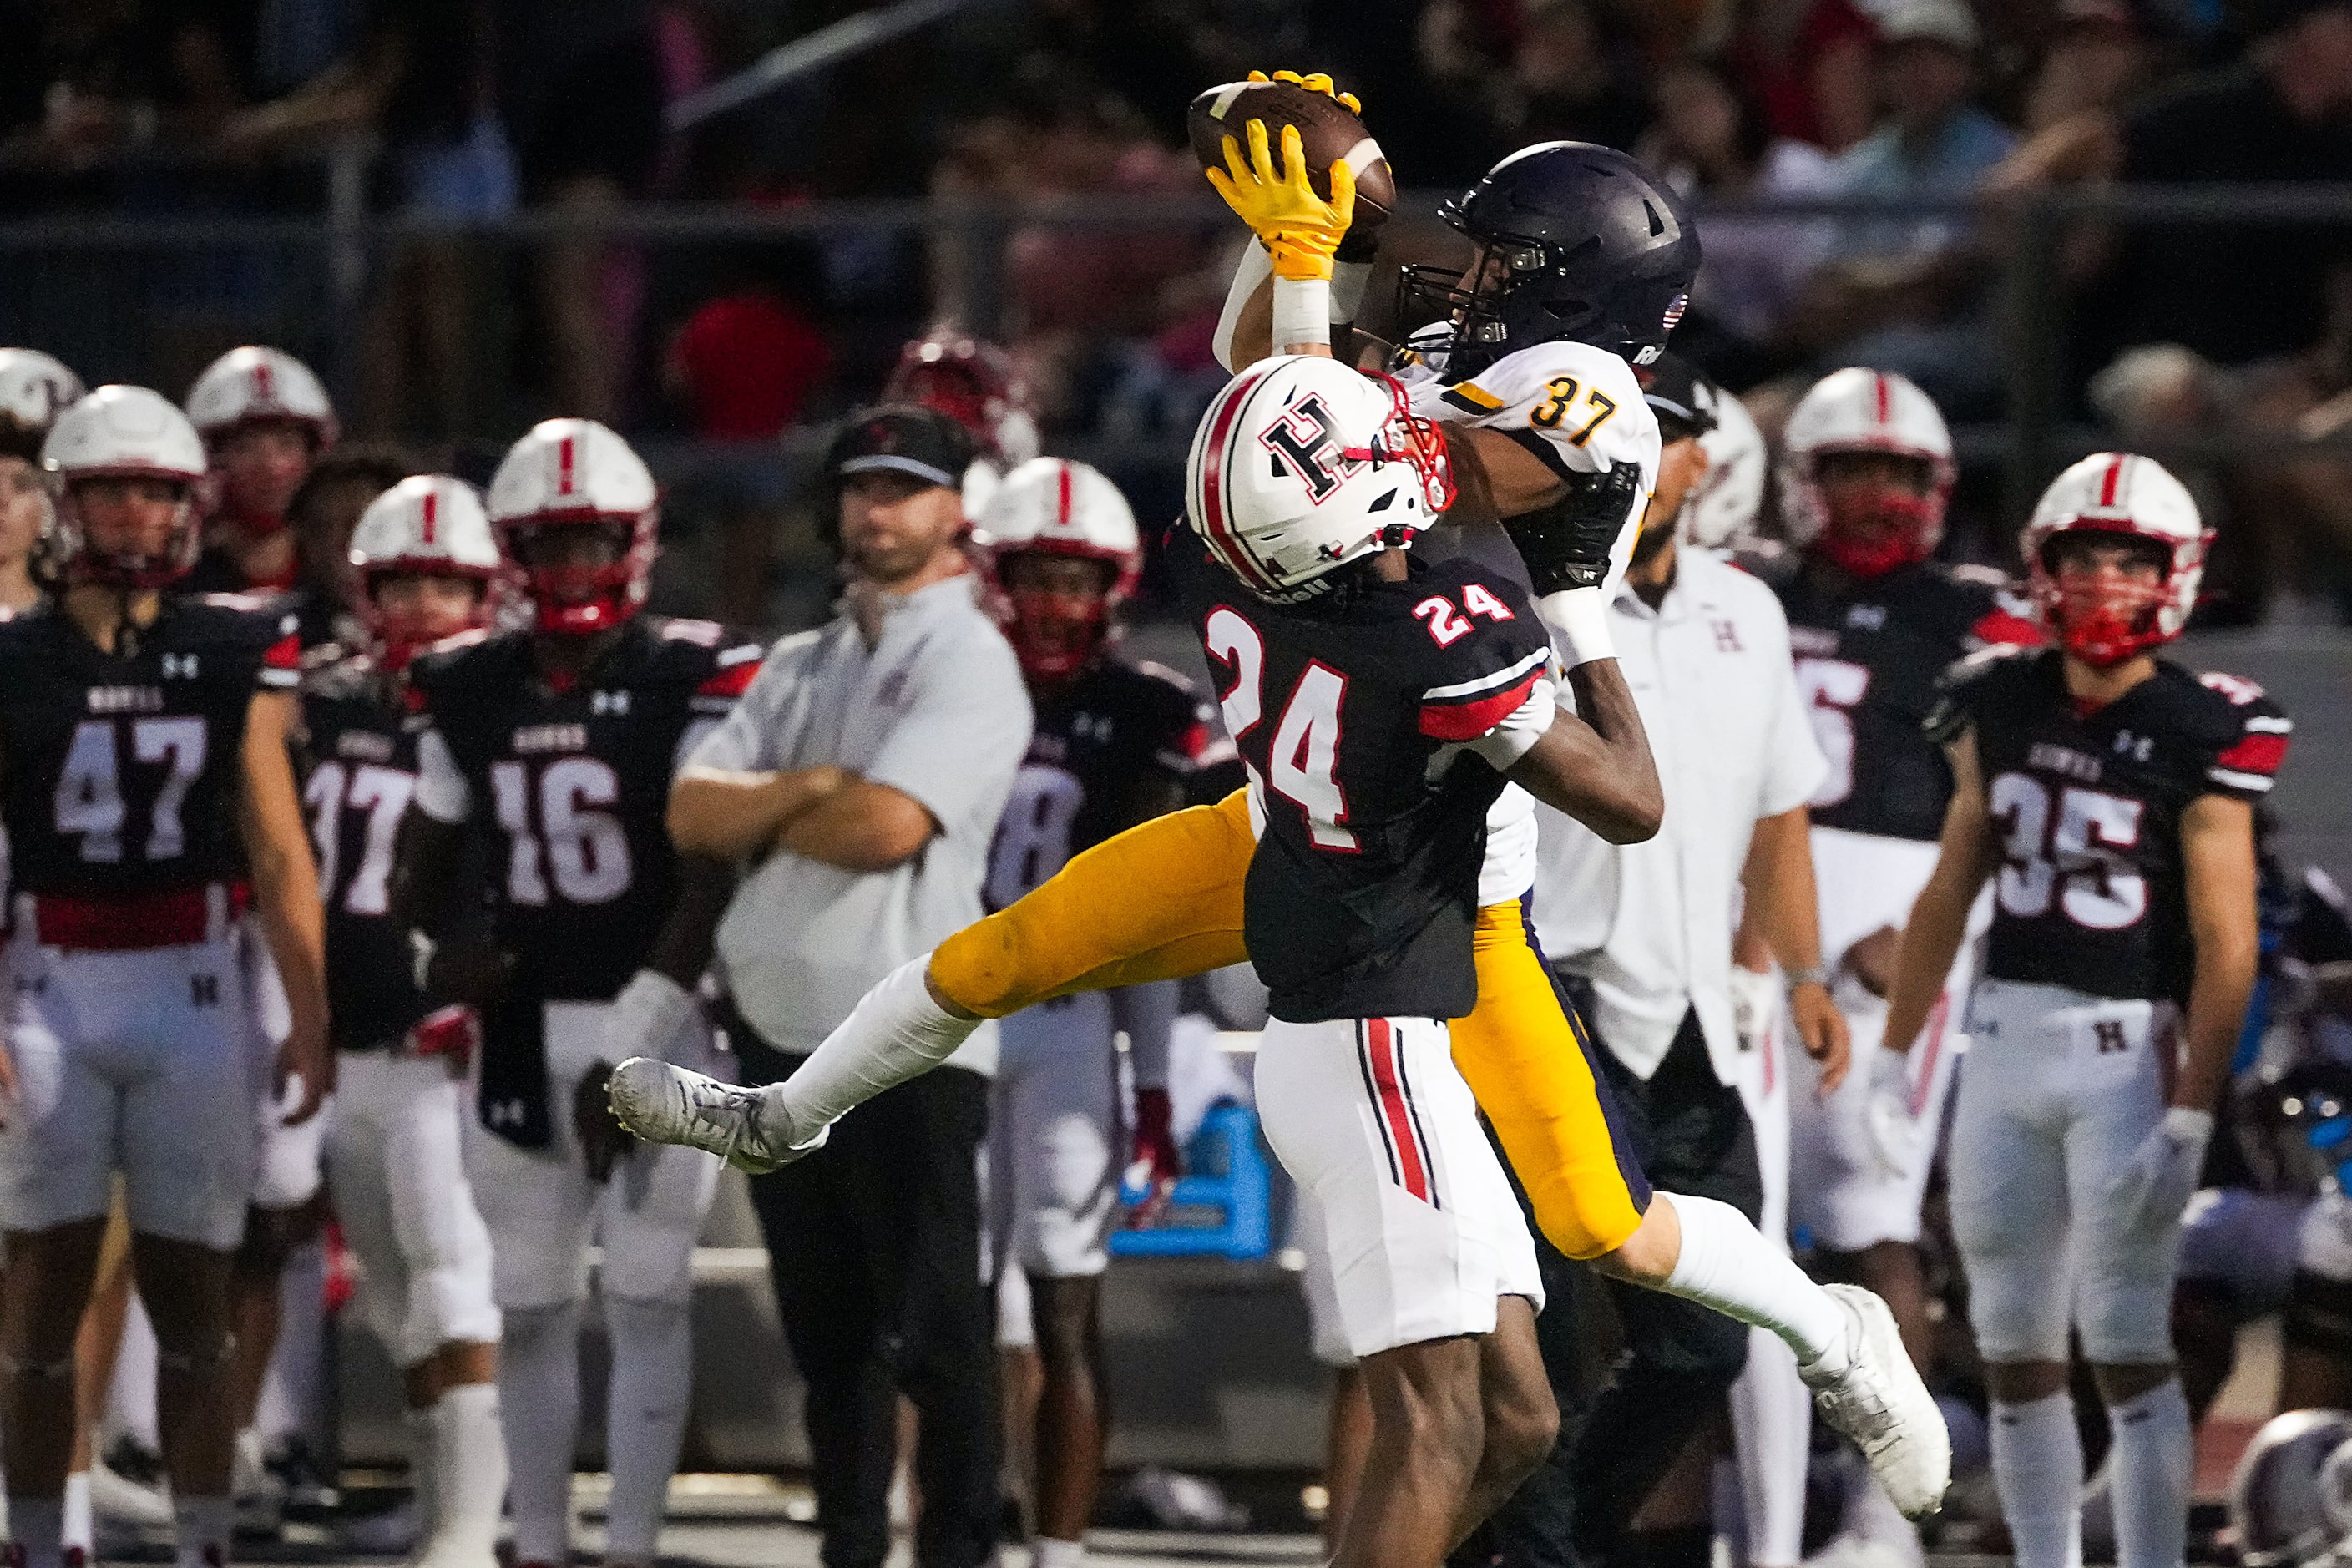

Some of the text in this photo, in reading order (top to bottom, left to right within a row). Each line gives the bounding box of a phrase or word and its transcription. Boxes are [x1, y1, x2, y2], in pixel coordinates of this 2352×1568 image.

[1258, 392, 1368, 506] H
[1528, 376, 1618, 448] 37
[1413, 583, 1515, 649] 24
[53, 716, 207, 863] 47
[1205, 604, 1363, 853] 24
[491, 756, 633, 906] 16
[1990, 772, 2147, 929] 35
